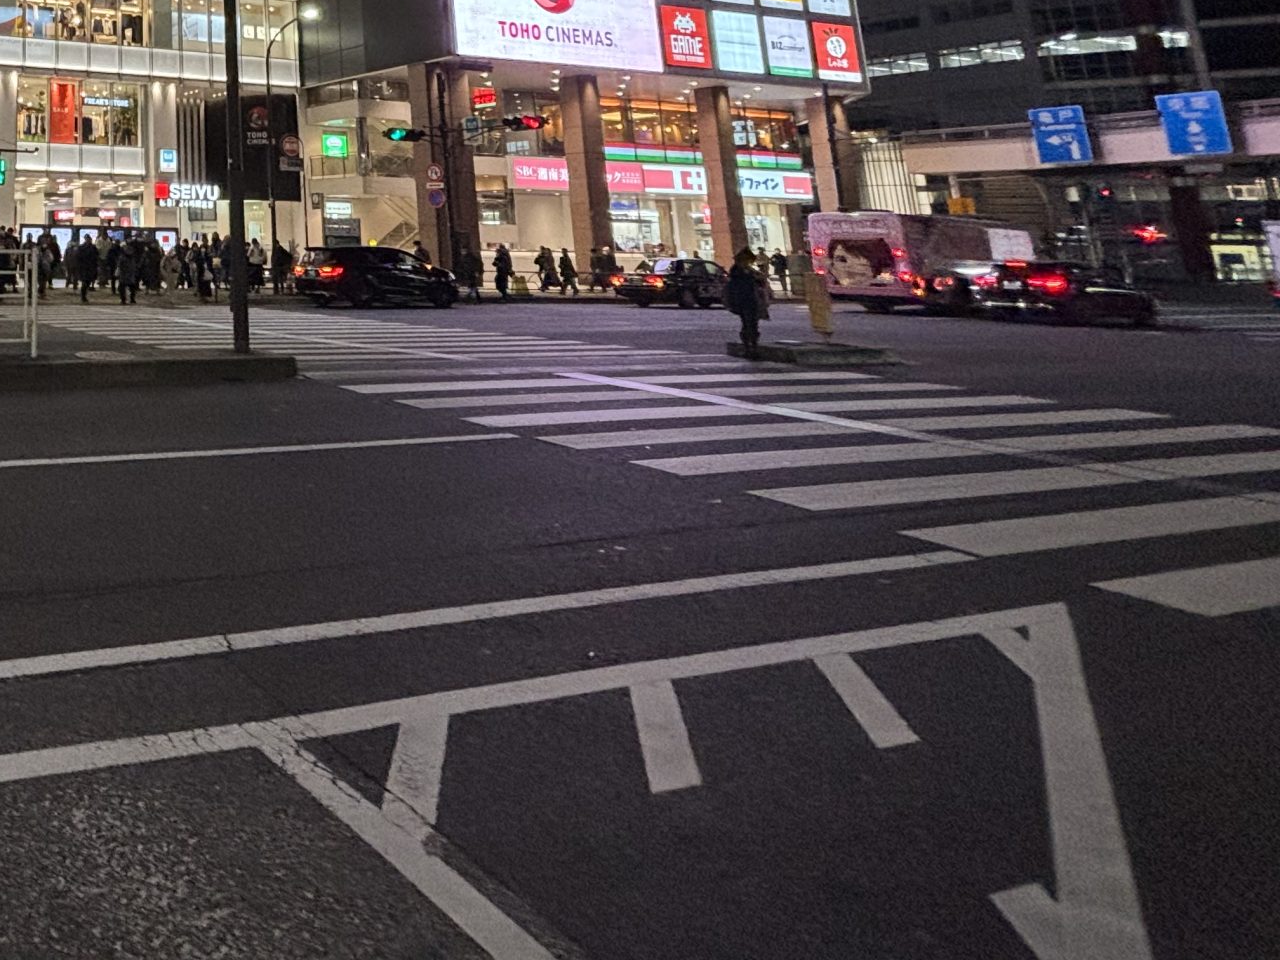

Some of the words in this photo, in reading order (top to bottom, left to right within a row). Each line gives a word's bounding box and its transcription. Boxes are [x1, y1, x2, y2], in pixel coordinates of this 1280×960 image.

[498, 20, 542, 41] TOHO
[670, 34, 705, 56] GAME
[246, 131, 268, 139] TOHO
[515, 164, 536, 177] SBC
[169, 183, 221, 201] SEIYU
